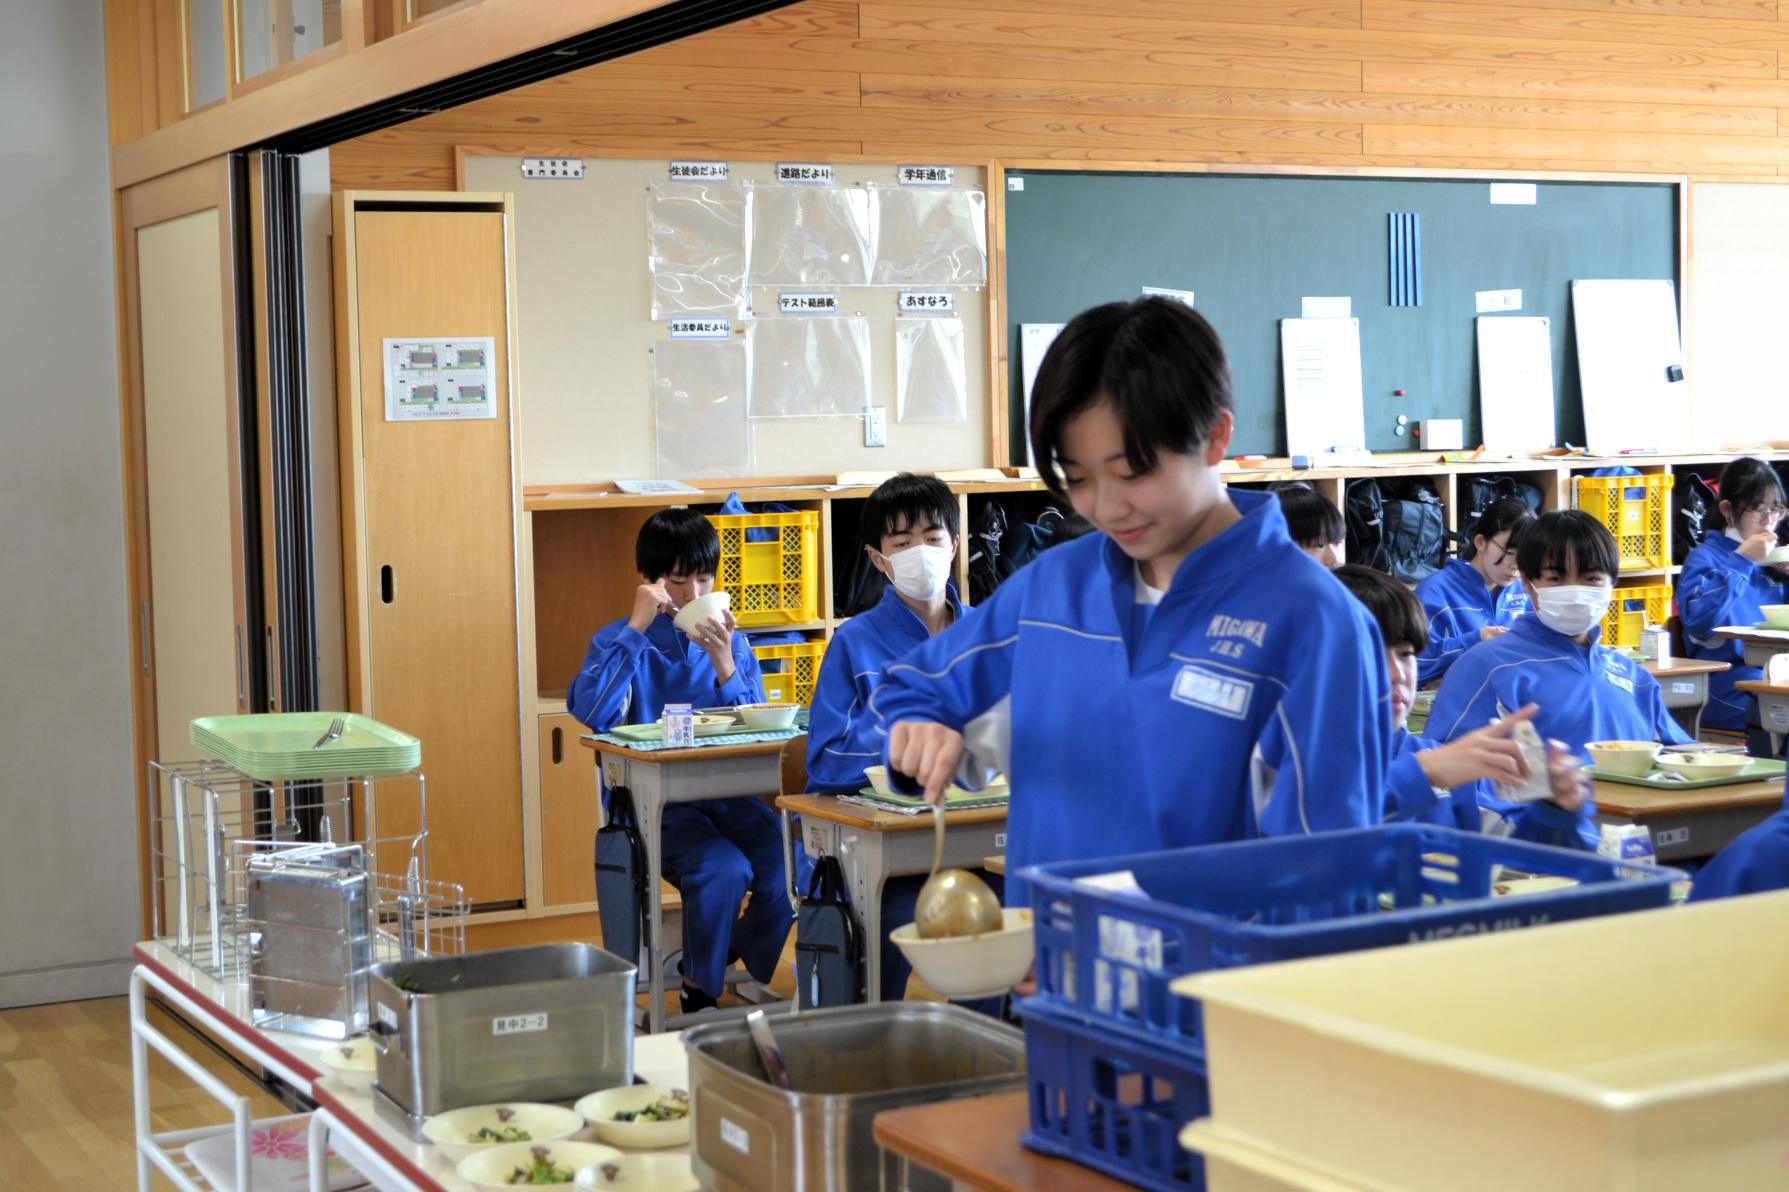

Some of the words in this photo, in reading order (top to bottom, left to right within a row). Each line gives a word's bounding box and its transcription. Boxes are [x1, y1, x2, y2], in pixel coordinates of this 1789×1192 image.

[671, 165, 726, 177] 生徒会だより
[780, 167, 830, 180] 進路だより
[904, 168, 947, 181] 学年通信
[782, 297, 835, 308] テスト範囲表
[906, 295, 949, 308] あすなろ
[672, 322, 727, 333] 生活委員だより
